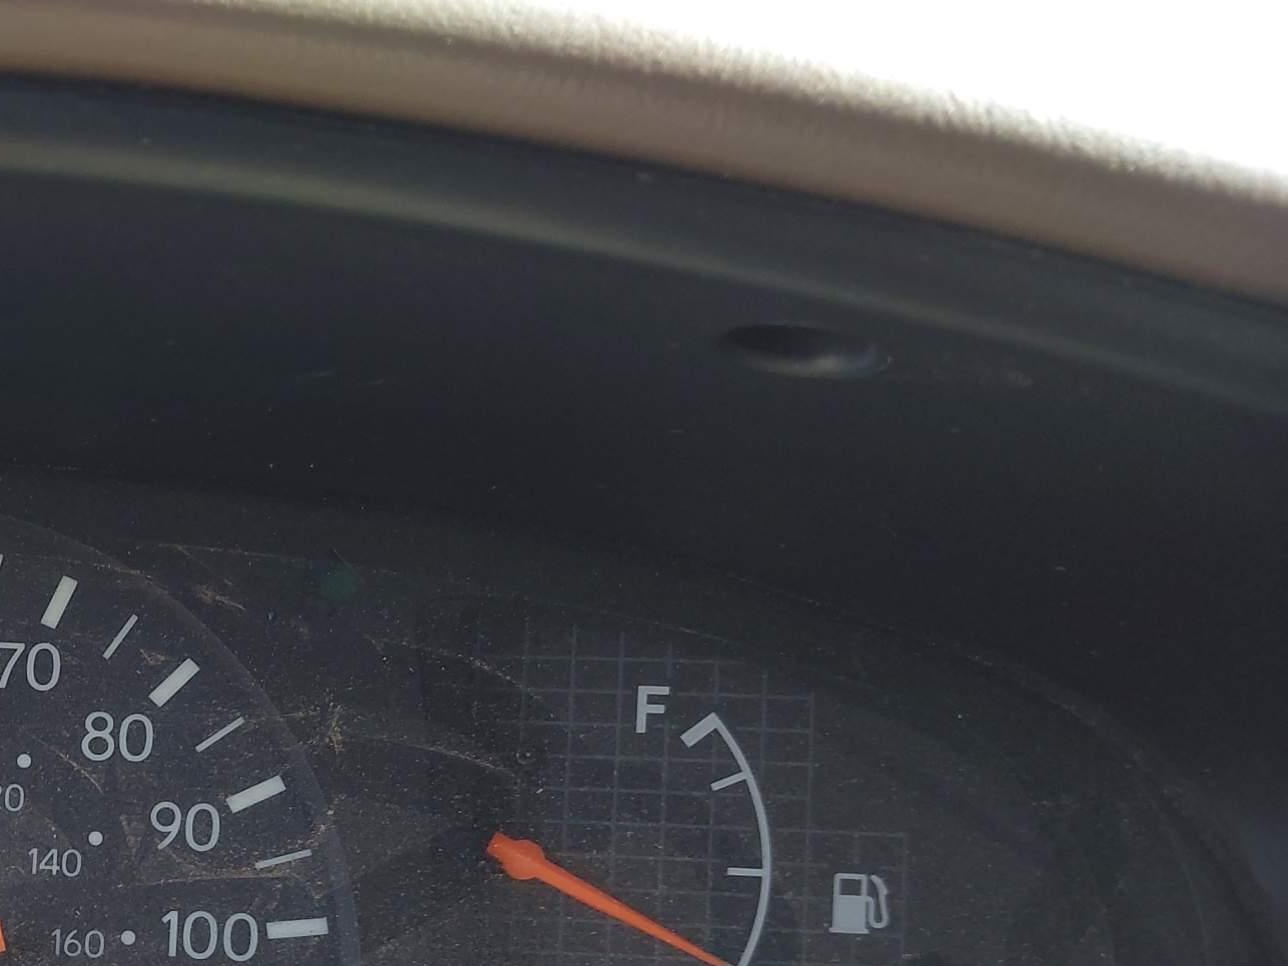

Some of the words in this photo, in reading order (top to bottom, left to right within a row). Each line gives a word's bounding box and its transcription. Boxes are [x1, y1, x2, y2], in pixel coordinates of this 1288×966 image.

[636, 686, 670, 733] F
[82, 712, 153, 761] 80
[151, 802, 219, 851] 90
[29, 848, 81, 876] 140
[52, 929, 104, 958] 160
[162, 911, 258, 961] 100
